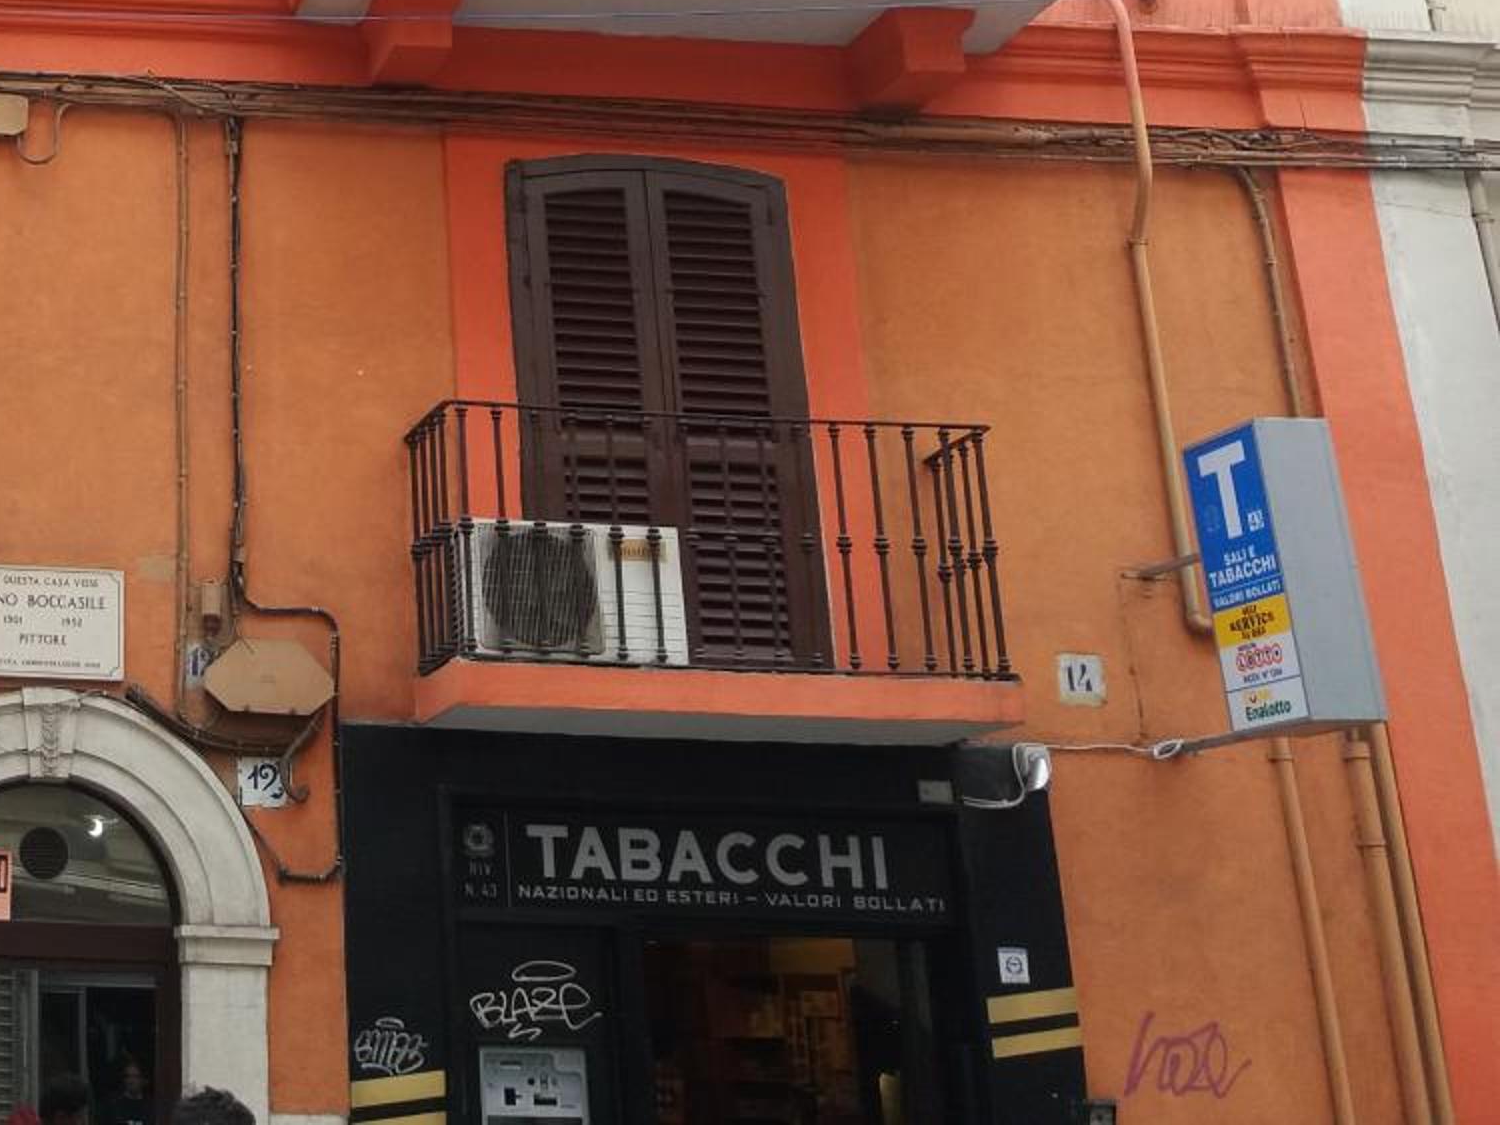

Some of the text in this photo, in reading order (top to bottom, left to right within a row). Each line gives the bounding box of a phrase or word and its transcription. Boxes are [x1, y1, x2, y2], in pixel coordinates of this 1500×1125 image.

[1197, 440, 1245, 539] T
[3, 576, 40, 586] QUESTA
[44, 578, 69, 587] CASA
[1209, 555, 1277, 588] TABACCHI
[27, 594, 107, 610] BOCCASILE
[19, 633, 68, 646] PITTORE
[526, 824, 889, 890] TABACCHI
[518, 884, 627, 902] NAZIONALI
[634, 887, 658, 903] ED
[667, 889, 739, 905] ESTERI
[765, 892, 841, 908] VALORI
[853, 895, 946, 912] BOLLATI
